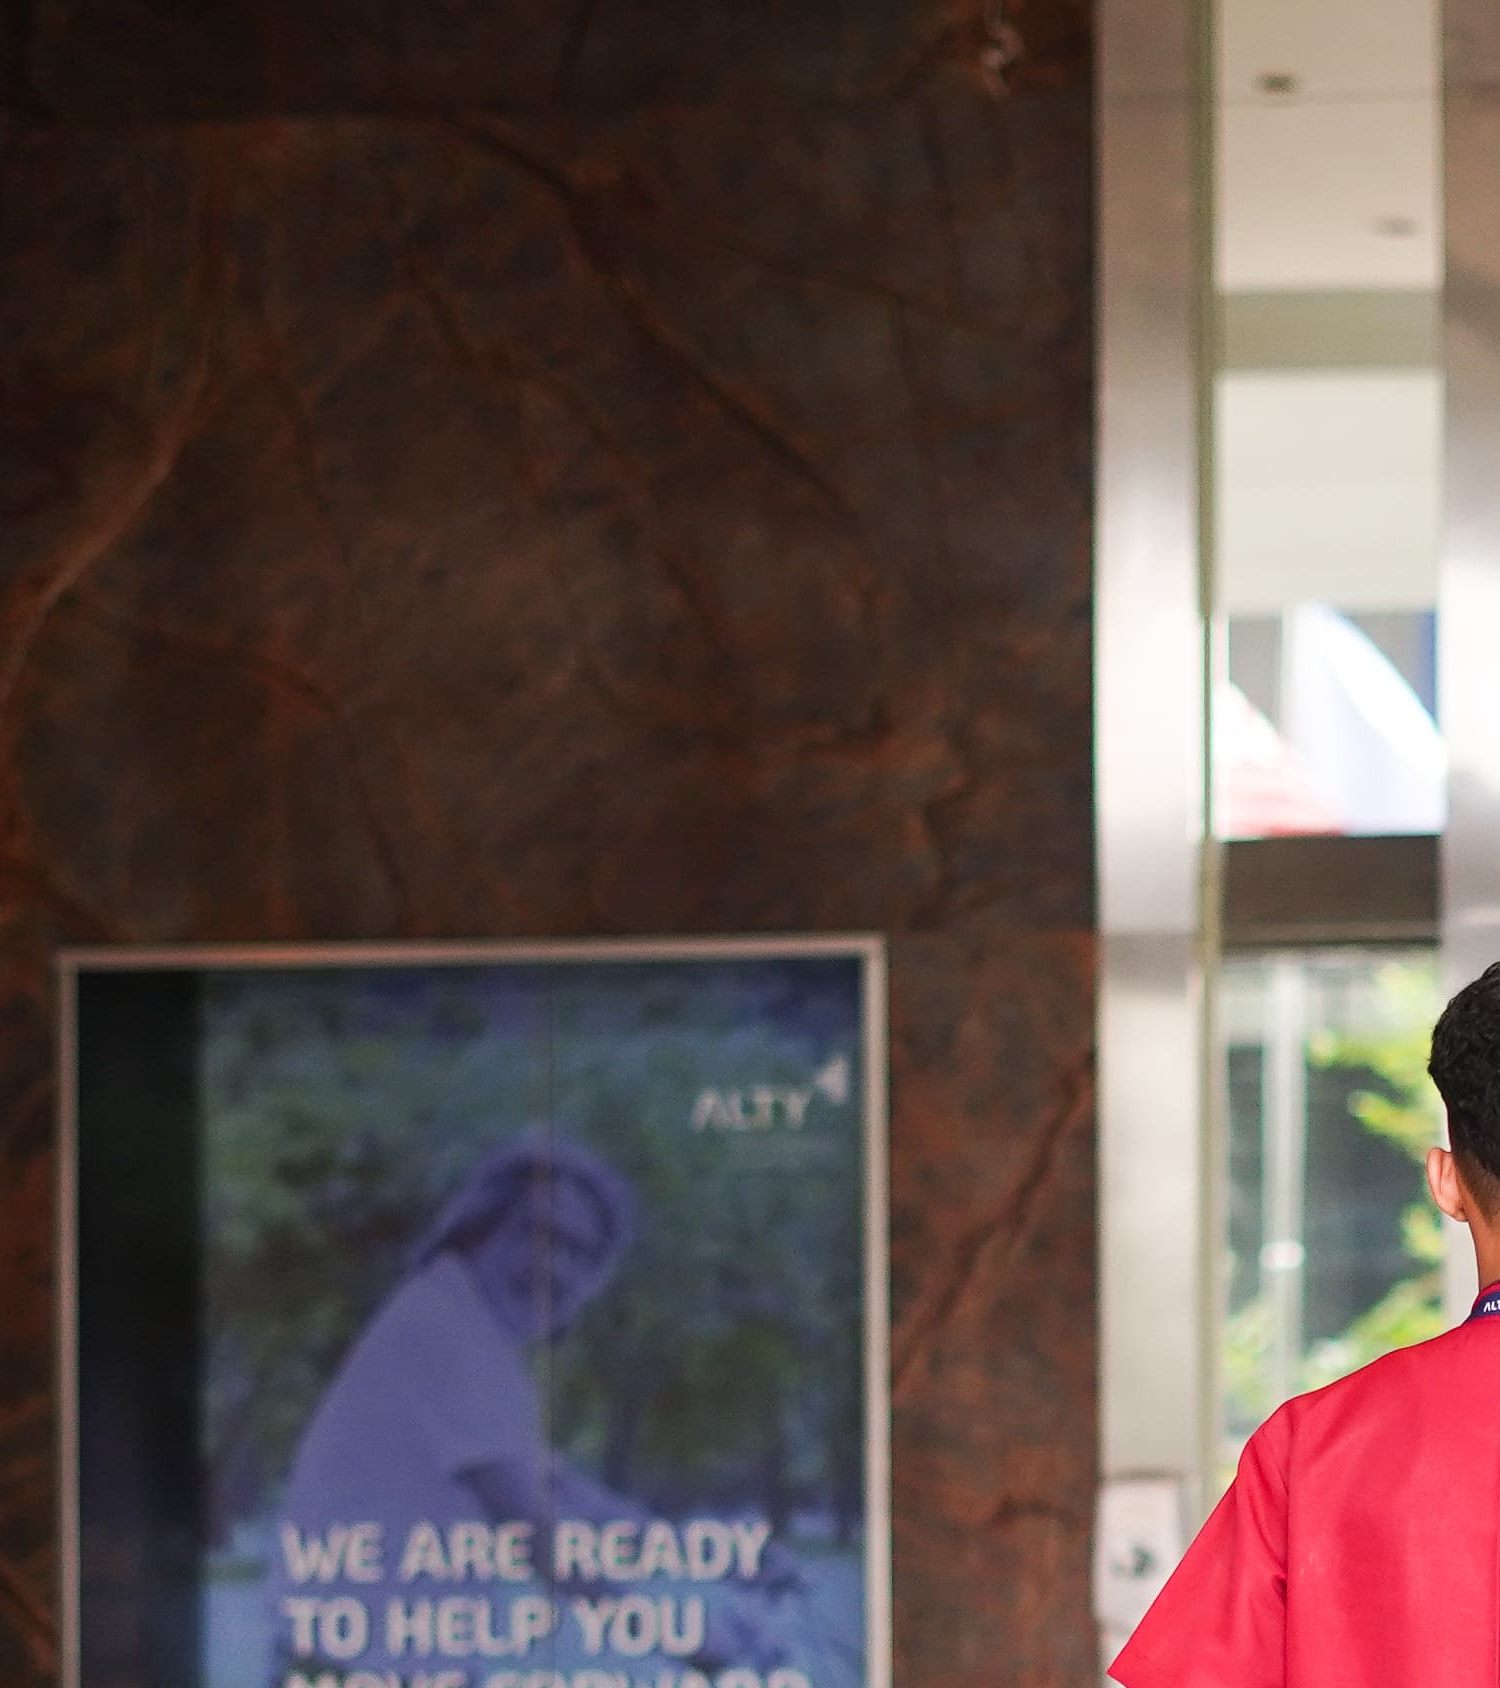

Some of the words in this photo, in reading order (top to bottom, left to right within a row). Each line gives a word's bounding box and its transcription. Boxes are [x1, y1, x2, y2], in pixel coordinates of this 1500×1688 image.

[693, 1087, 812, 1133] ALTY
[281, 1522, 384, 1582] WE
[401, 1522, 535, 1580] ARE
[553, 1520, 773, 1580] READY
[284, 1598, 370, 1658] TO
[387, 1598, 558, 1656] HELP
[575, 1597, 704, 1656] YOU
